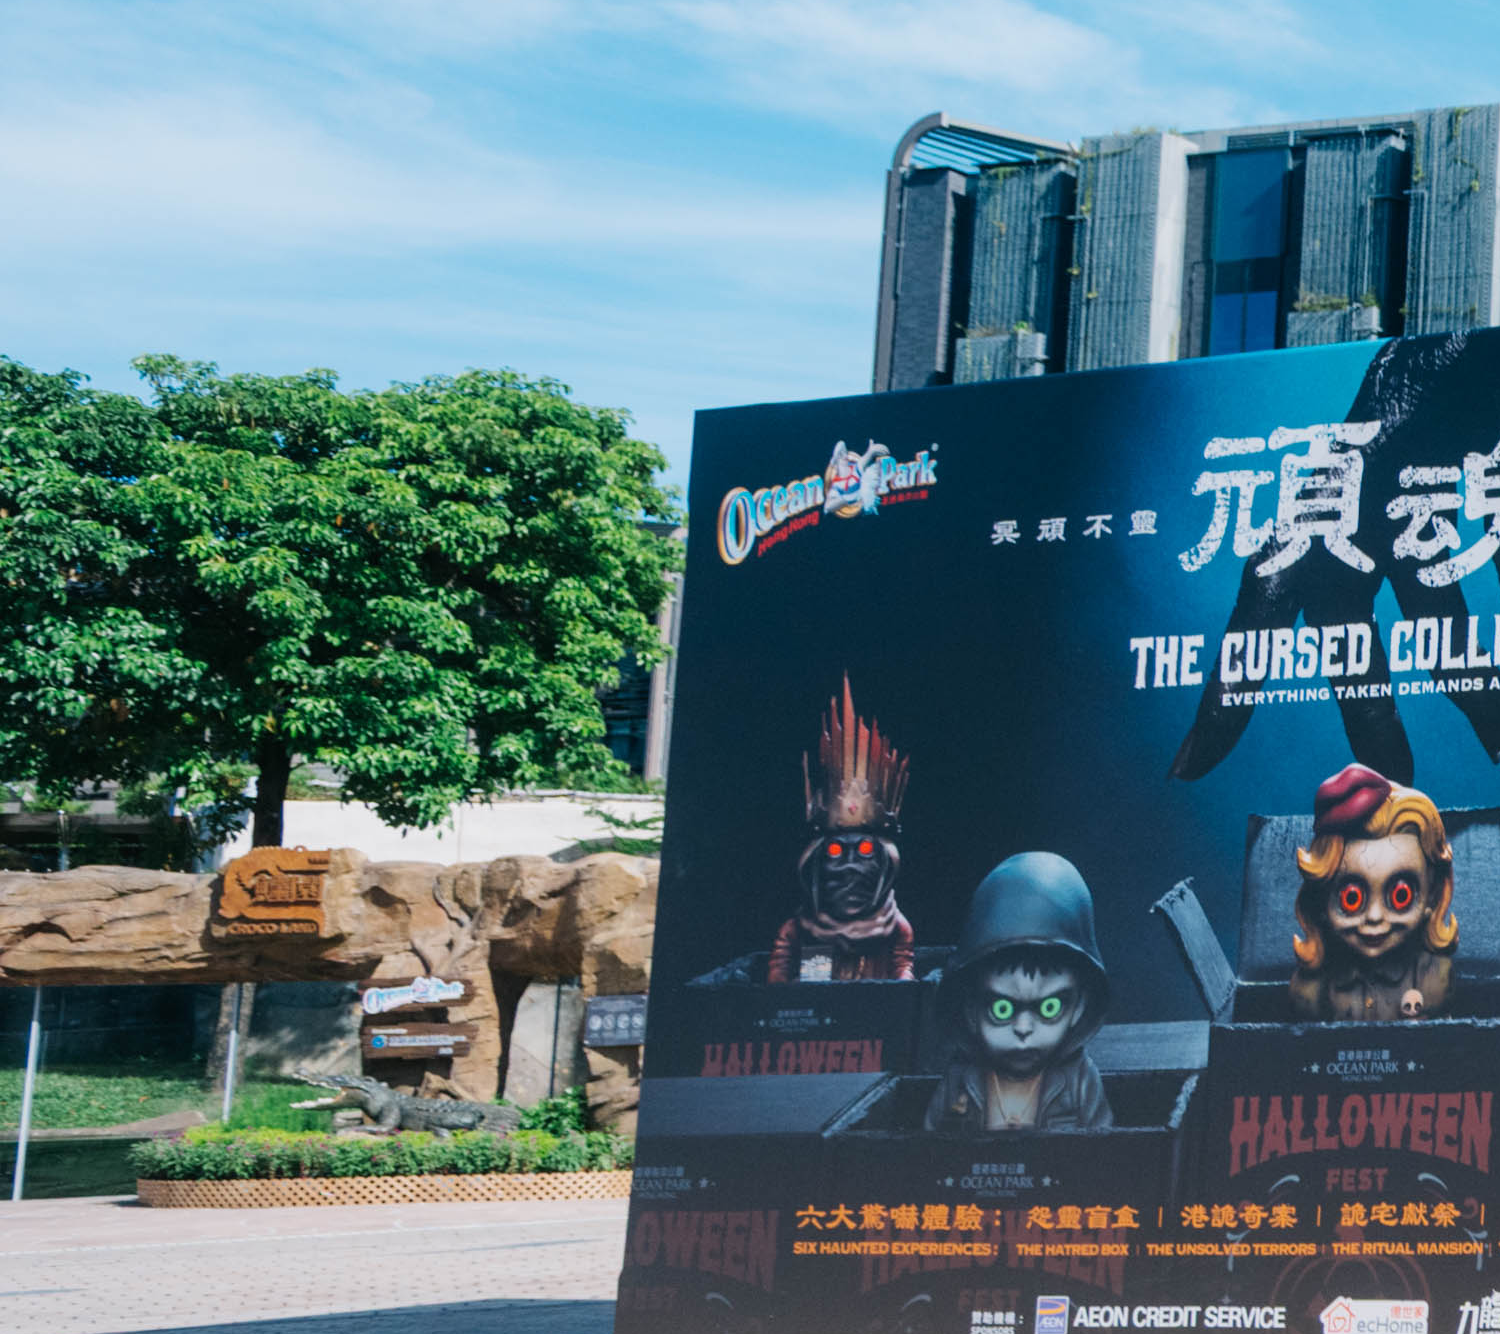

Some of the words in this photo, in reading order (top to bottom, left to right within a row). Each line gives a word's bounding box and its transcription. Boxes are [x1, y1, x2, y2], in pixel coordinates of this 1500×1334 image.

[718, 475, 825, 565] Ocean
[875, 450, 938, 495] Park
[757, 525, 789, 558] Hong
[789, 510, 820, 534] Kong
[990, 509, 1158, 545] 冥頑不靈
[1129, 634, 1204, 689] THE
[1221, 622, 1372, 683] CURSED
[1222, 687, 1330, 706] EVERYTHING
[1336, 683, 1392, 699] TAKEN
[1398, 677, 1485, 694] DEMANDS
[1489, 676, 1500, 690] A
[1326, 1062, 1368, 1075] OCEAN
[1371, 1061, 1399, 1074] PARK
[1229, 1091, 1493, 1178] HALLOWEEN
[960, 1176, 1001, 1189] OCEAN
[1003, 1175, 1035, 1188] PARK
[1325, 1168, 1388, 1192] FEST
[1026, 1204, 1140, 1229] 怨靈盲盒
[1181, 1203, 1298, 1228] 港詭奇案
[1340, 1202, 1461, 1227] 詭宅獻祭
[793, 1242, 817, 1254] SIX
[820, 1242, 889, 1255] HAUNTED
[1016, 1243, 1043, 1255] THE
[1045, 1243, 1099, 1256] HATRED
[1101, 1243, 1129, 1256] BOX
[1146, 1243, 1174, 1255] THE
[1176, 1243, 1250, 1256] UNSOLVED
[1253, 1243, 1317, 1255] TERRORS
[1331, 1243, 1361, 1255] THE
[1363, 1243, 1414, 1255] RITUAL
[1417, 1242, 1484, 1255] MANSION
[1073, 1306, 1129, 1328] AEON
[1132, 1306, 1201, 1328] CREDIT
[1204, 1305, 1287, 1328] SERVICE
[1357, 1317, 1424, 1334] ecHome
